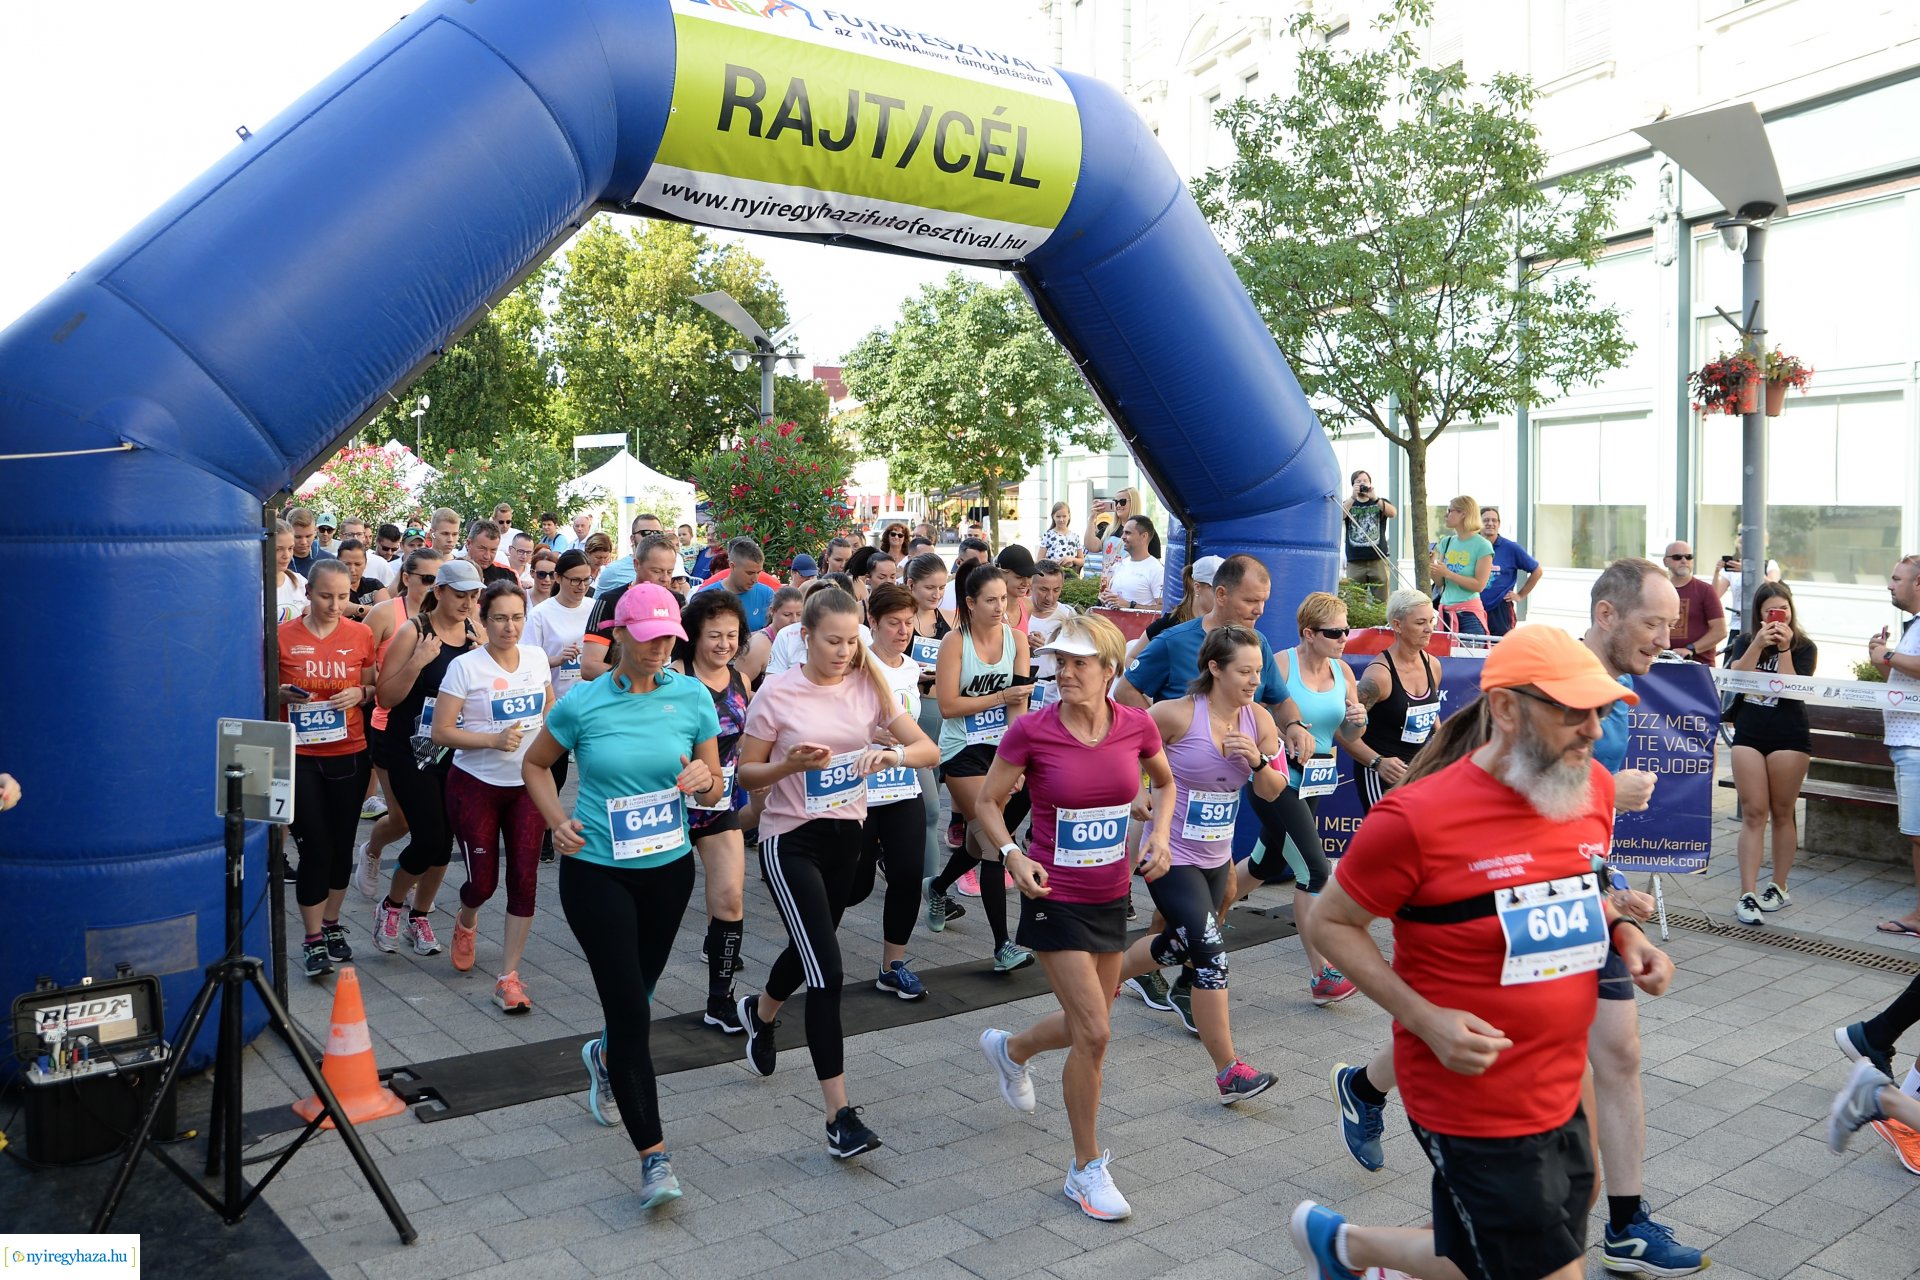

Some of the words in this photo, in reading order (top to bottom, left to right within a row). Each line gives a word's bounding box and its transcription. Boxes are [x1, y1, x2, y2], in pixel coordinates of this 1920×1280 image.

[835, 26, 853, 38] az
[717, 63, 1041, 190] RAJT/CÉL
[660, 182, 1028, 253] www.nyiregyhazifutofesztival.hu
[921, 646, 939, 660] 62
[305, 660, 347, 679] RUN
[968, 673, 1009, 694] NIKE
[1784, 684, 1815, 693] MOZAIK
[502, 695, 536, 715] 631
[300, 710, 336, 727] 546
[974, 708, 1005, 726] 506
[1415, 711, 1437, 729] 583
[1666, 715, 1710, 733] MEG,
[1636, 735, 1659, 751] TE
[1664, 736, 1711, 753] VAGY
[820, 765, 859, 788] 599
[876, 766, 907, 783] 517
[1310, 767, 1334, 782] 601
[275, 798, 286, 815] 7
[1200, 803, 1233, 821] 591
[625, 803, 674, 831] 644
[1072, 820, 1118, 843] 600
[1527, 899, 1590, 942] 604
